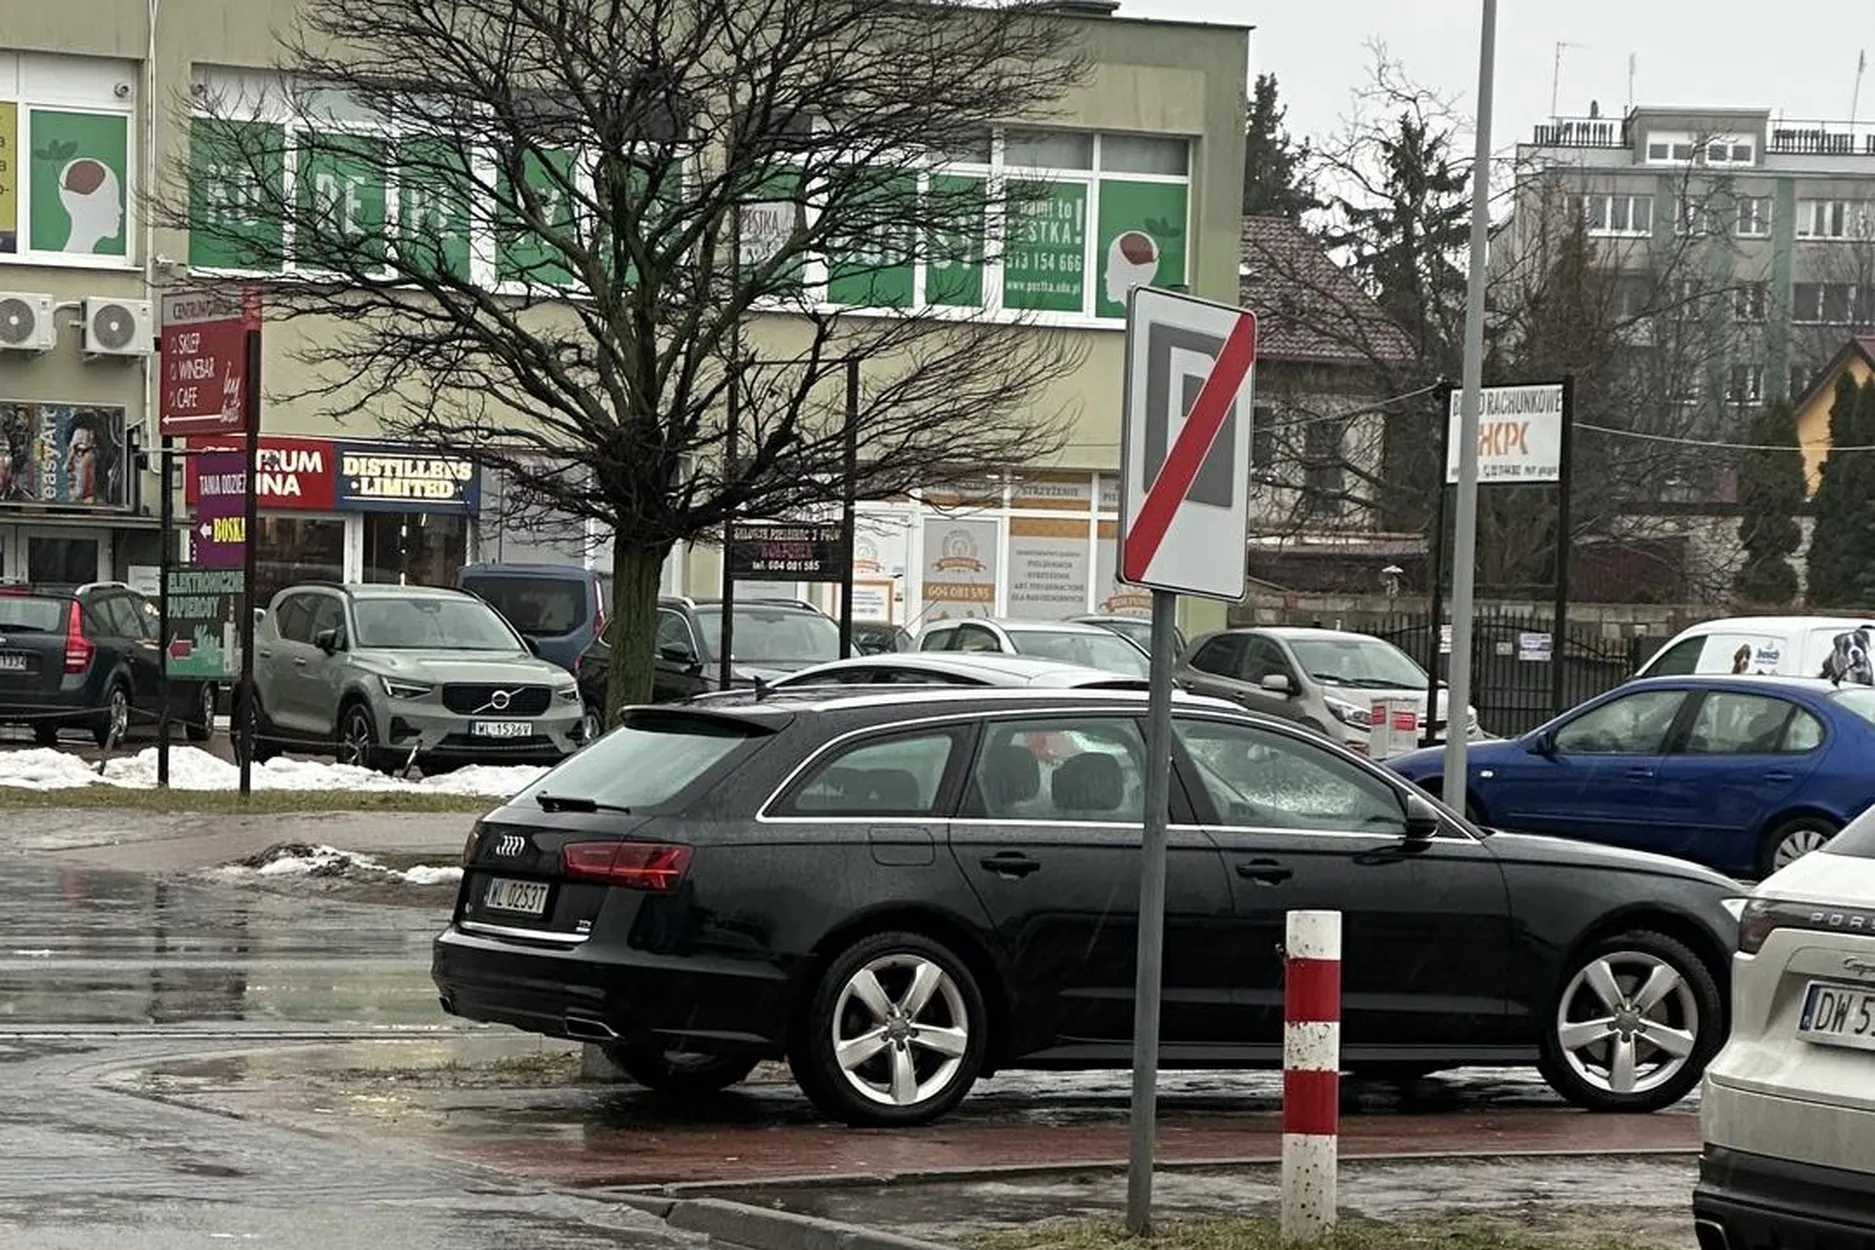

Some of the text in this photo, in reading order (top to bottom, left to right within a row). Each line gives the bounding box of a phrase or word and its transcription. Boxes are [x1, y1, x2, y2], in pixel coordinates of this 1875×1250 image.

[343, 457, 472, 480] DISTILLERS
[256, 473, 301, 496] INA
[360, 477, 455, 498] LIMITED
[1814, 991, 1853, 1033] DW
